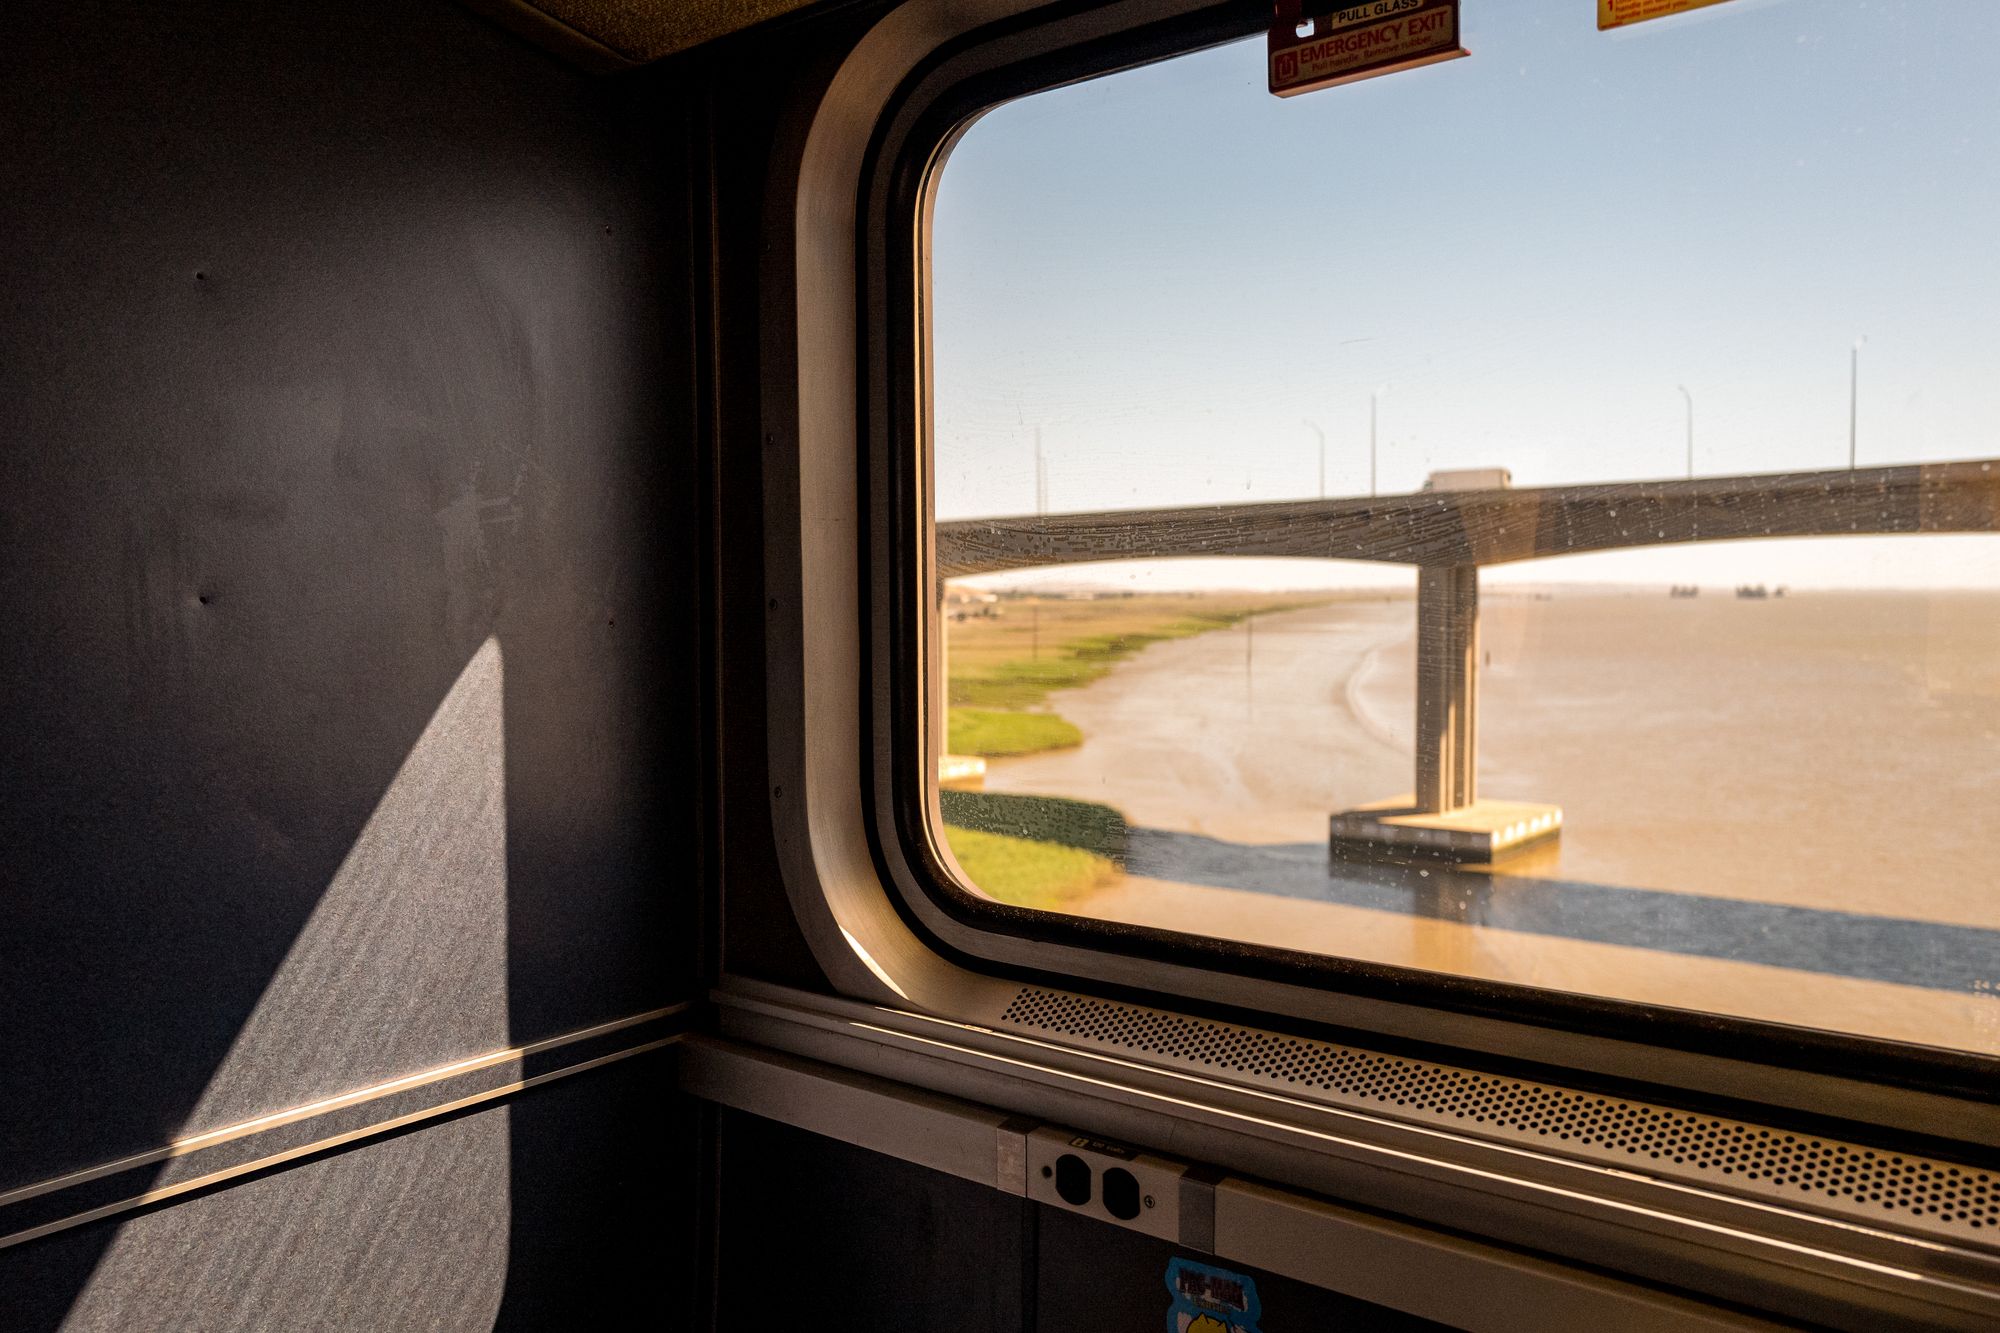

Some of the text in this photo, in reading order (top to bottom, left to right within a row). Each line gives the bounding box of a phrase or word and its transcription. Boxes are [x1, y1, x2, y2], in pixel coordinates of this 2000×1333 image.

[1338, 0, 1418, 23] PULL GLASS
[1300, 11, 1447, 64] EMERGENCY EXIT
